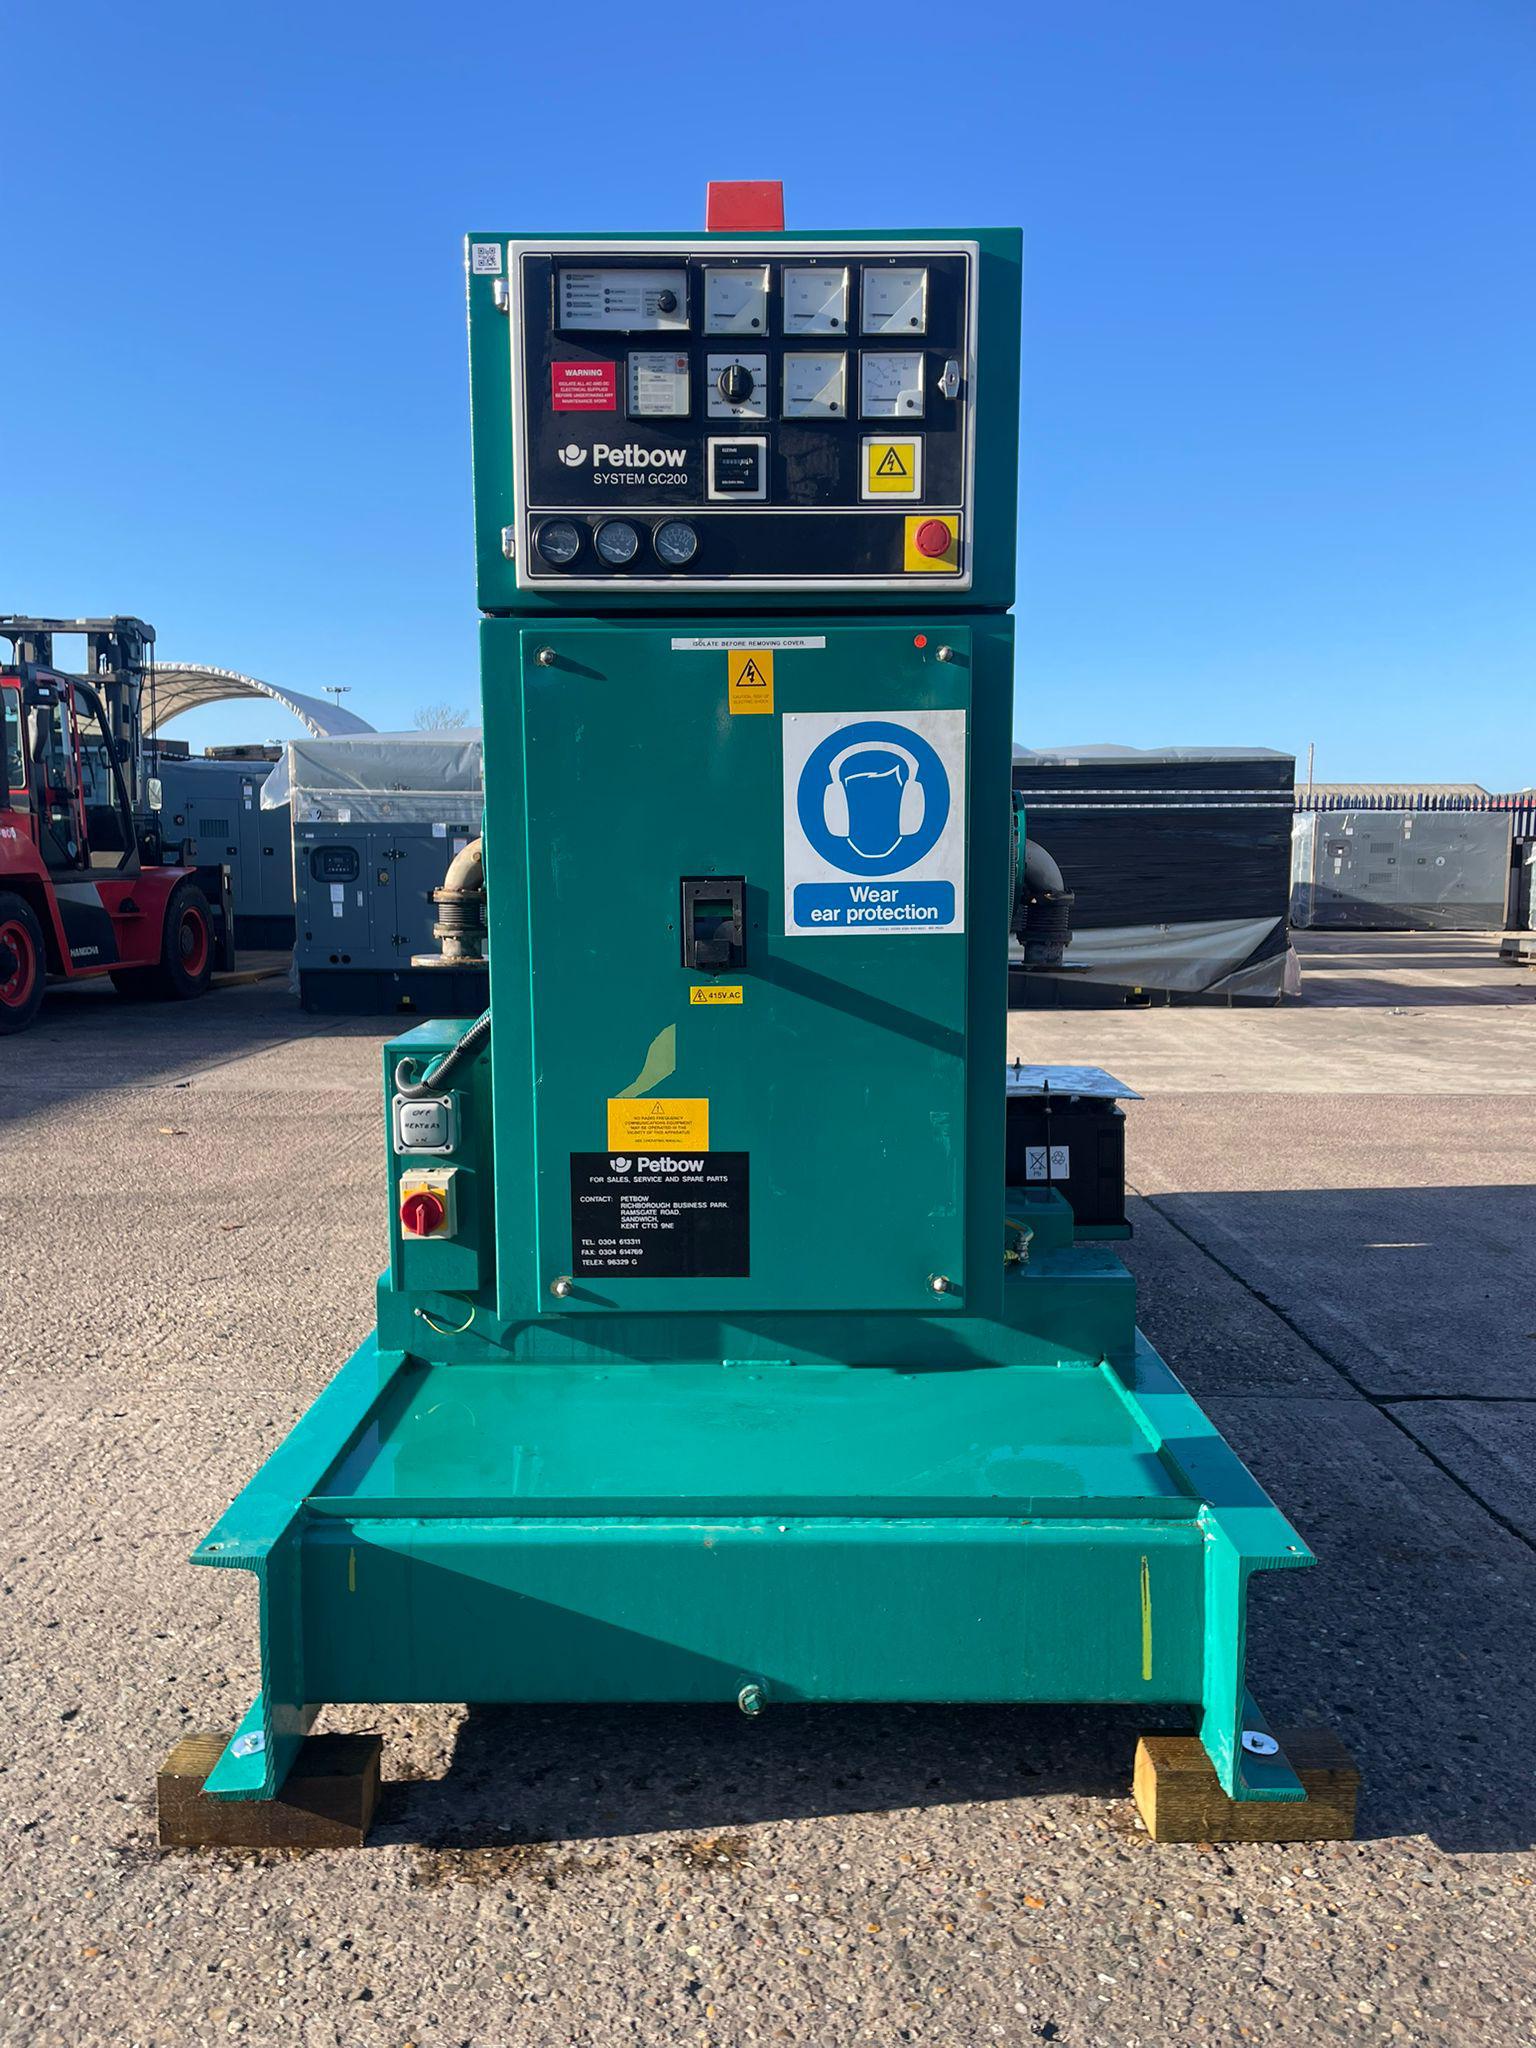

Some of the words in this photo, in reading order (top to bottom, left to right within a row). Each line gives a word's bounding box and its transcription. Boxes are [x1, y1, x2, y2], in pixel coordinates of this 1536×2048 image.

[593, 444, 686, 467] Petbow
[593, 473, 644, 484] SYSTEM
[648, 473, 688, 484] GC200
[850, 886, 899, 902] Wear
[810, 908, 840, 922] ear
[846, 904, 938, 924] protection
[638, 1157, 704, 1172] Petbow
